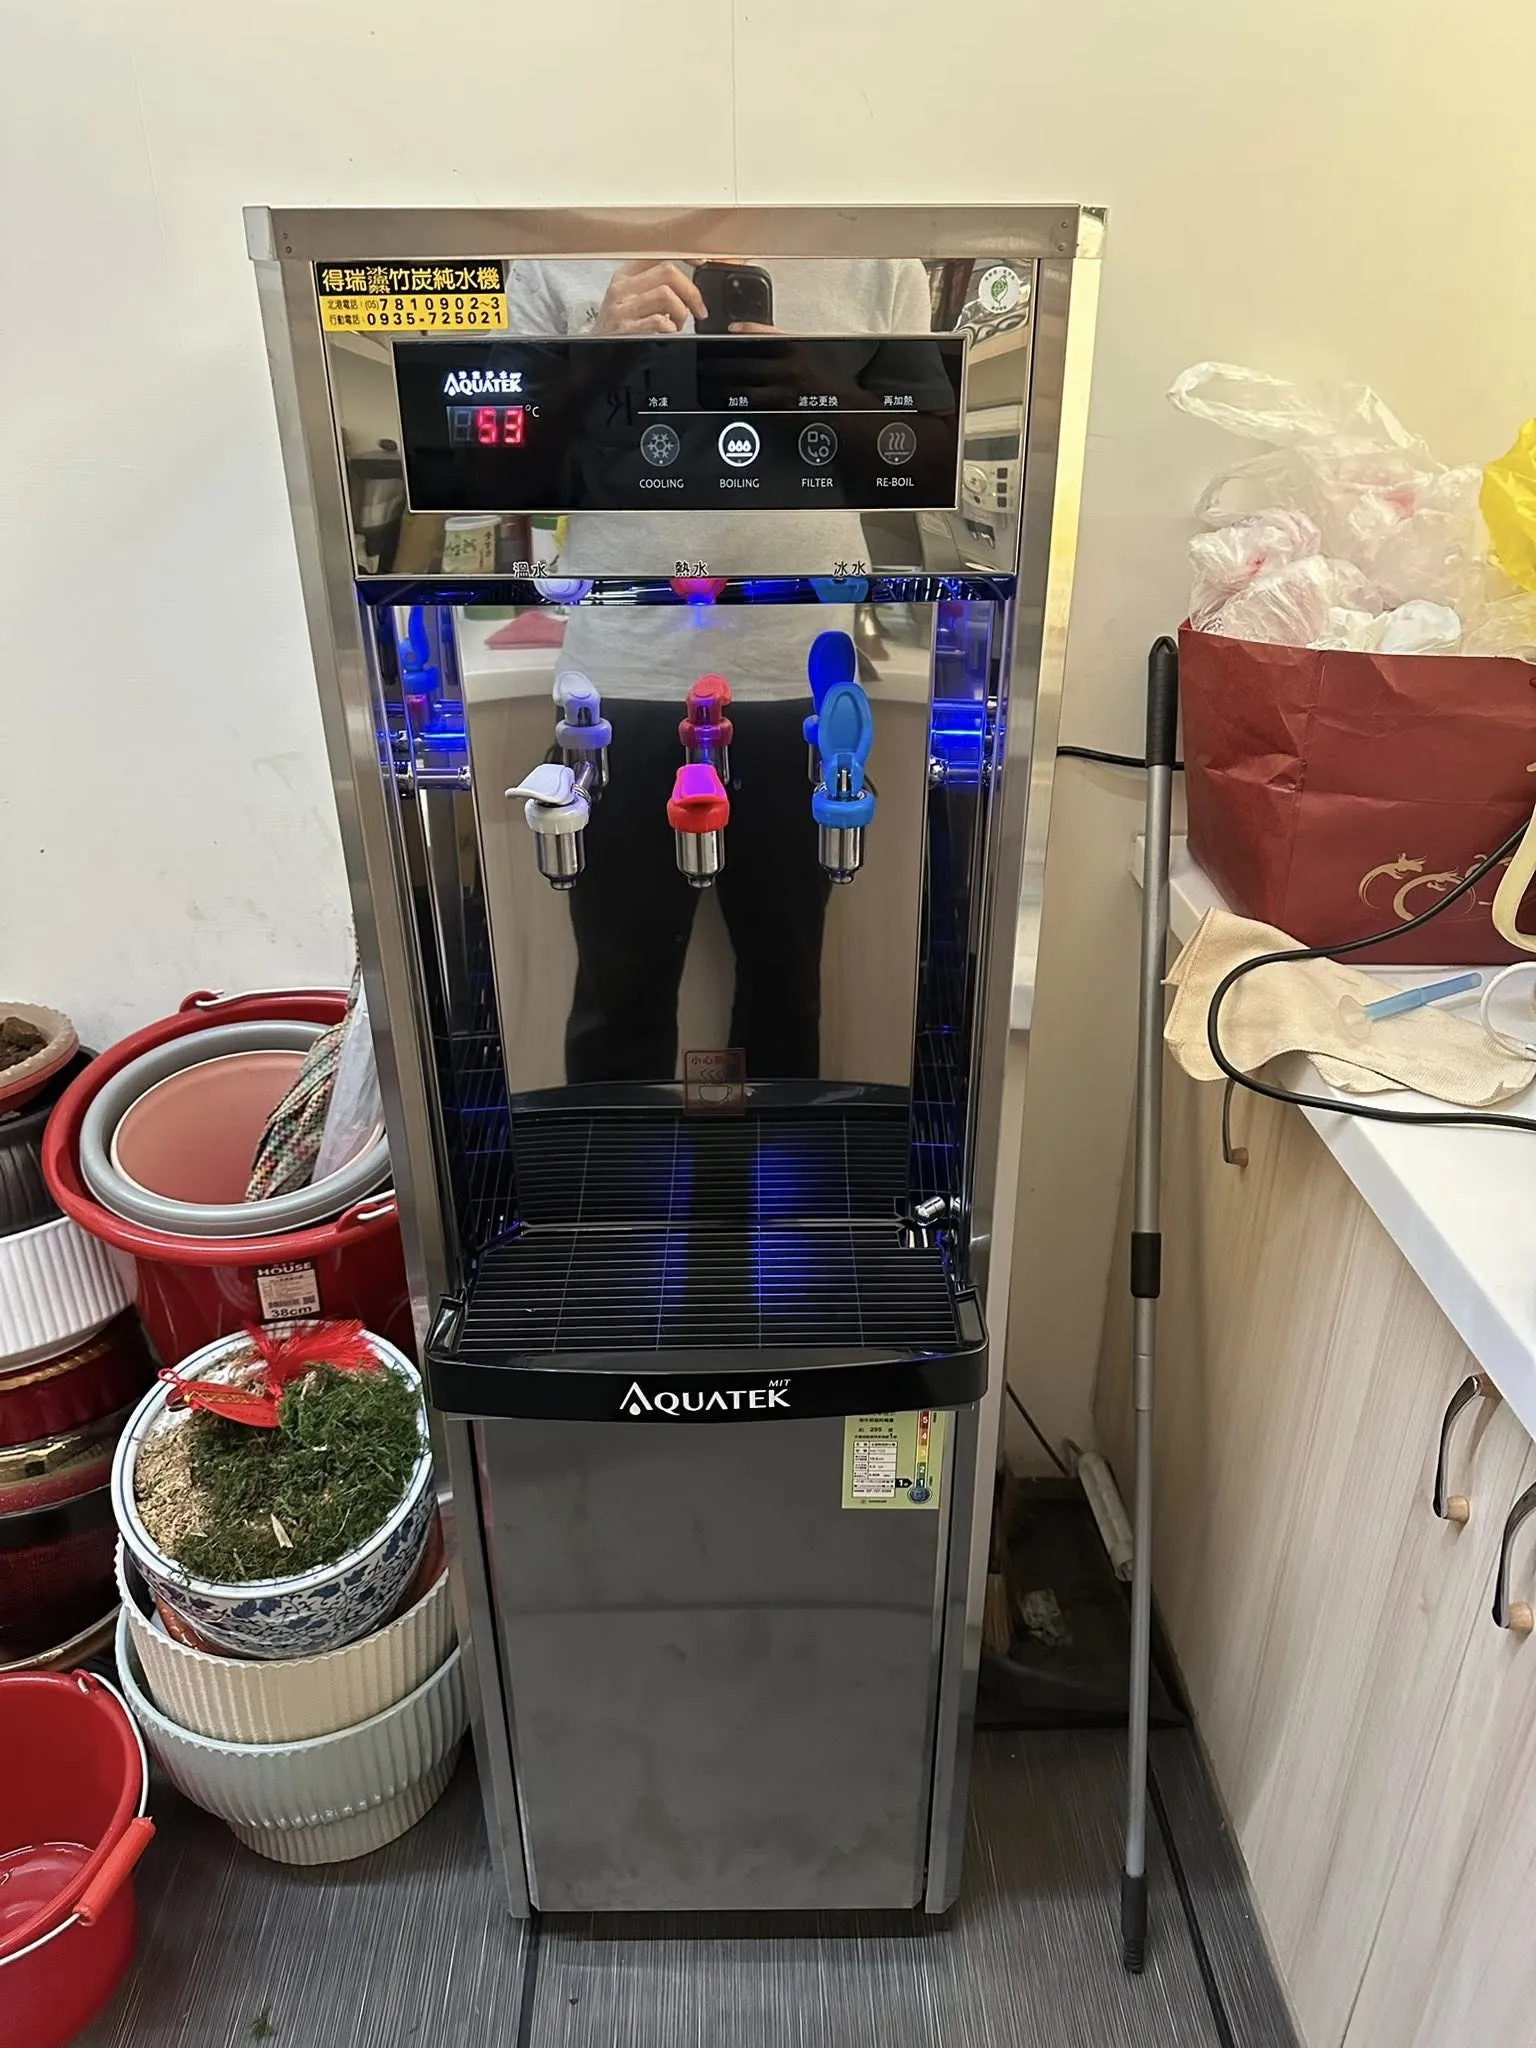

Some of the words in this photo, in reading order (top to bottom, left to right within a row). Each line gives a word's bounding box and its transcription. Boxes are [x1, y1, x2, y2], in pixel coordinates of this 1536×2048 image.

[367, 311, 501, 326] 0935-725021
[443, 373, 523, 397] AQUATEK
[648, 396, 669, 408] 冷凍
[728, 396, 749, 408] 加熱
[883, 395, 914, 406] 再加熱
[477, 409, 523, 444] 53
[639, 478, 684, 489] COOLING
[719, 478, 760, 489] BOILING
[801, 477, 834, 488] FILTER
[876, 477, 915, 488] RE-BOIL
[513, 561, 548, 578] 溫水
[674, 560, 709, 577] 熱水
[833, 560, 867, 577] 冰水
[257, 1261, 312, 1276] HOUSE
[271, 1306, 312, 1318] 38cm
[768, 1378, 791, 1387] MIT
[619, 1381, 791, 1416] AQUATEK
